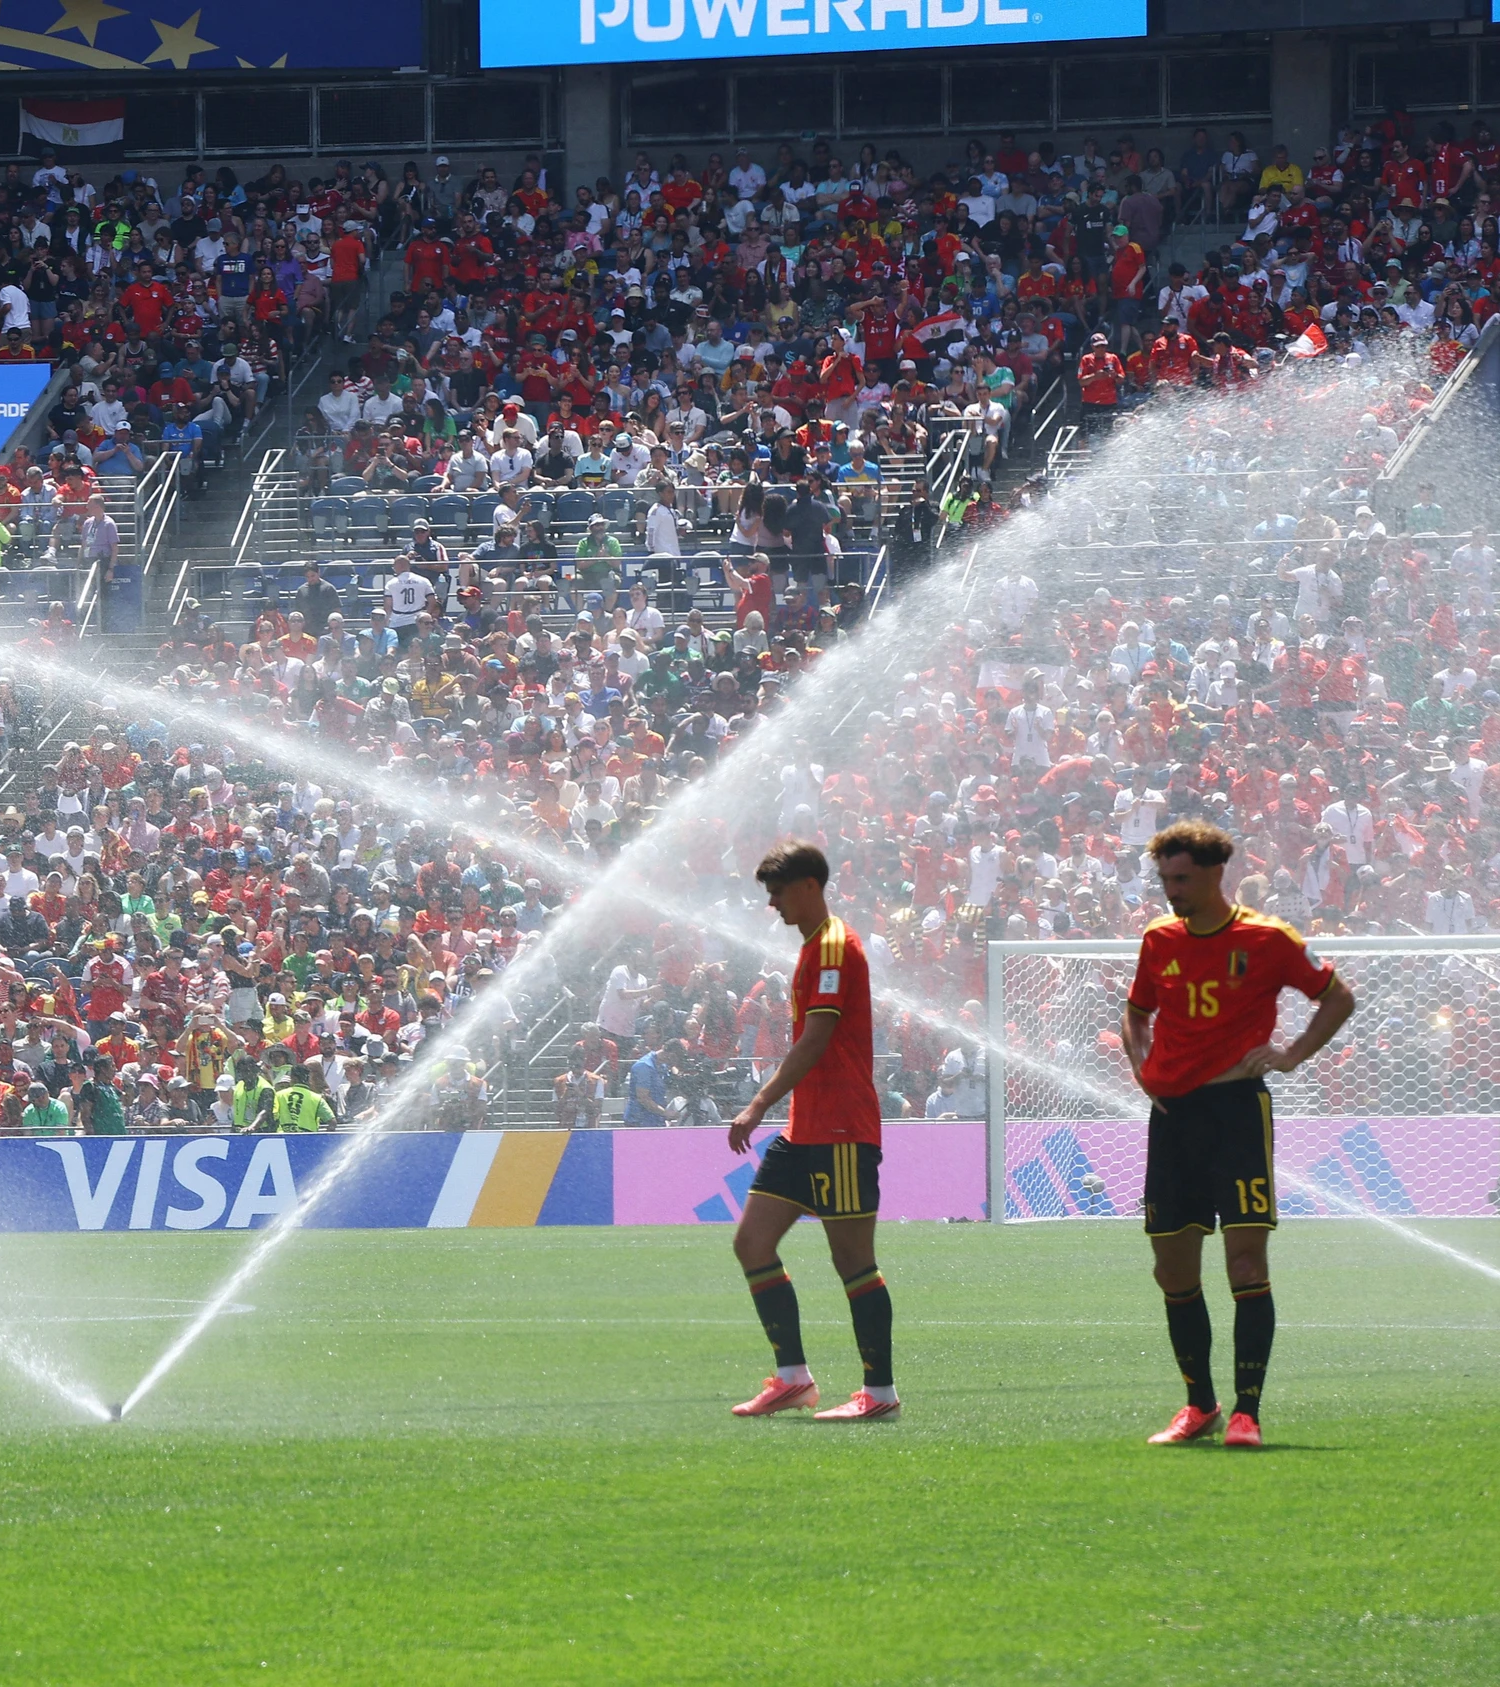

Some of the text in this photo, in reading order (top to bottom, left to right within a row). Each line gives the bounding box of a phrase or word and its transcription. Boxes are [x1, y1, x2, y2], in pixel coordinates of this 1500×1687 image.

[400, 587, 415, 605] 10
[1187, 980, 1219, 1018] 15
[35, 1138, 303, 1230] VISA
[809, 1172, 831, 1206] 17
[1235, 1177, 1269, 1214] 15
